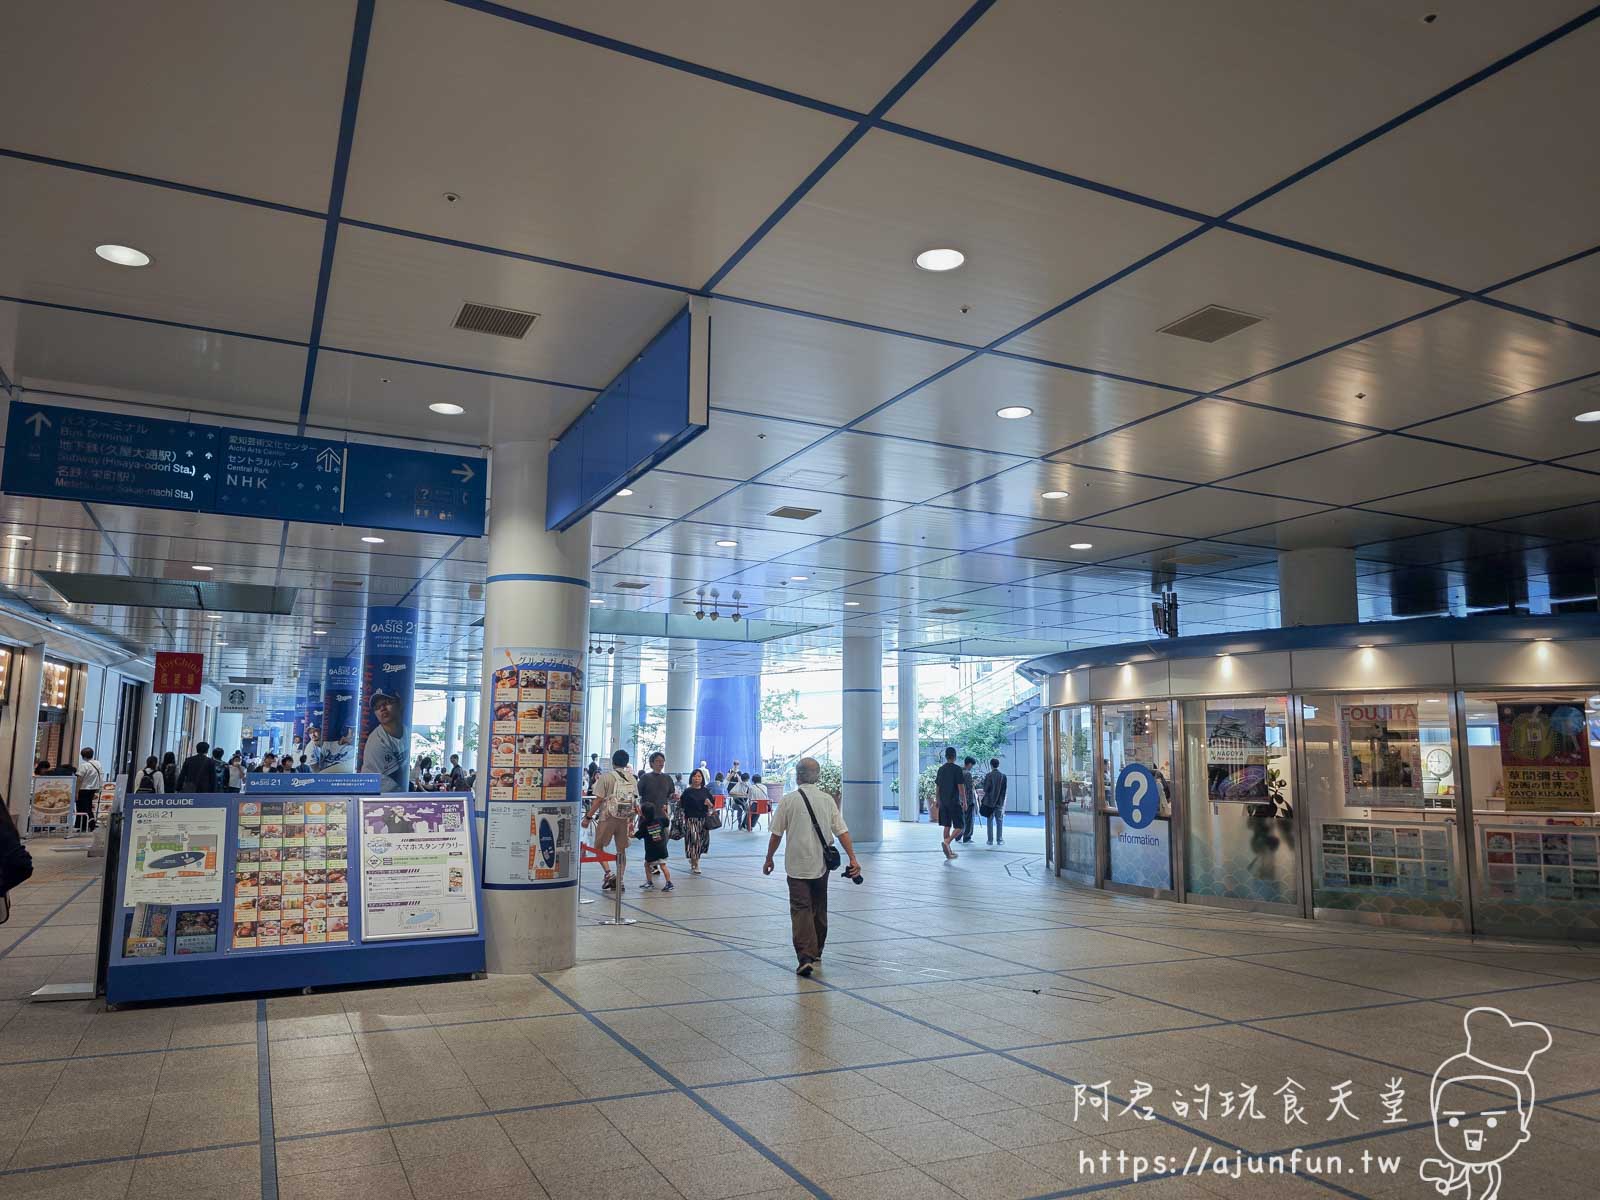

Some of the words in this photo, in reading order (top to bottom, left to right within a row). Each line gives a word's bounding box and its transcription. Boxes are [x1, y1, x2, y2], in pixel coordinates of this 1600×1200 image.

[173, 464, 196, 477] Sta.)
[174, 488, 194, 501] Sta.)
[371, 623, 403, 633] OASIS
[1341, 705, 1416, 721] FOUJITA
[133, 798, 164, 806] FLOOR
[166, 798, 194, 806] GUIDE
